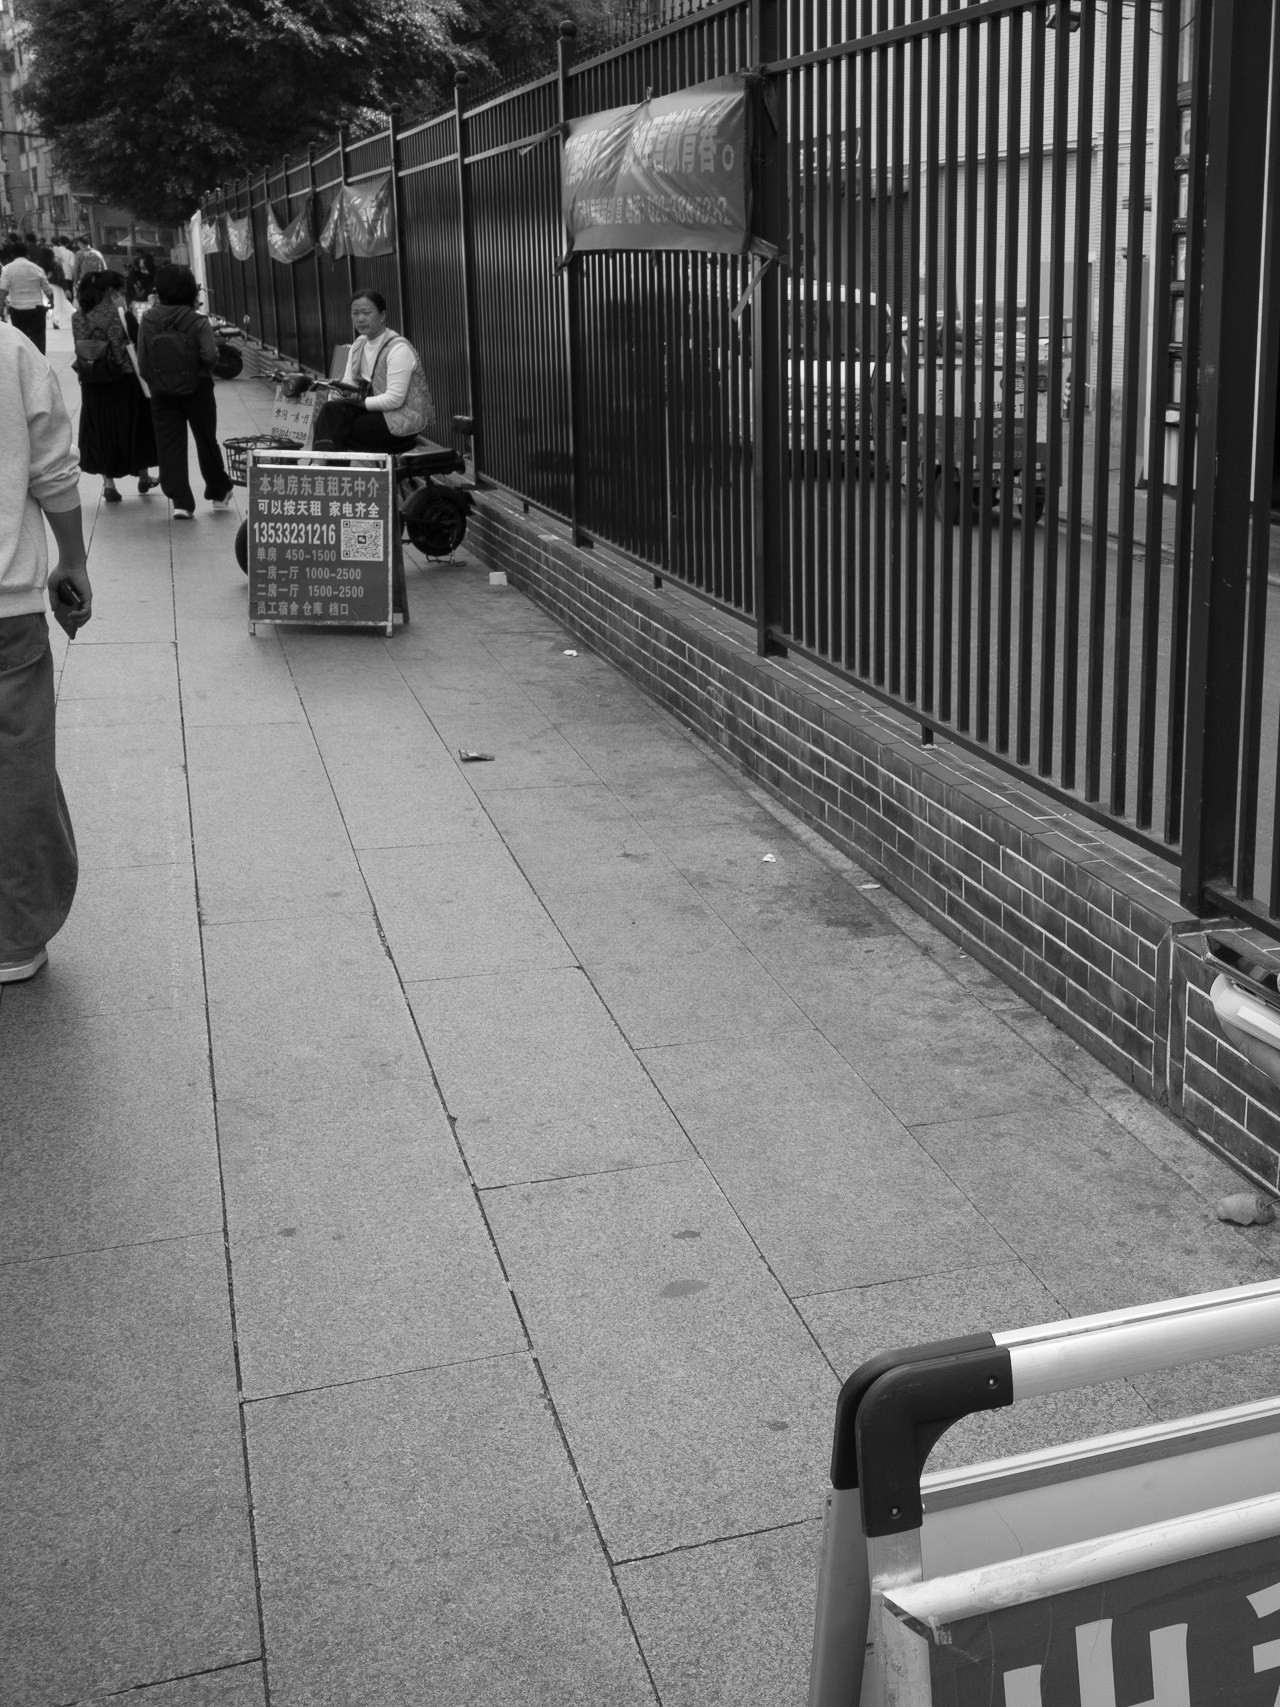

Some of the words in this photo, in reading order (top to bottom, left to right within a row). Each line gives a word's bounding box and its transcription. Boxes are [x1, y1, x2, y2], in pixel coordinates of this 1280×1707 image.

[260, 474, 379, 498] 本地房东直租无中介
[257, 499, 321, 516] 可以按天租
[329, 501, 380, 518] 家电齐全
[254, 521, 336, 545] 13533231216
[256, 546, 277, 562] 单房
[285, 548, 336, 562] 450-1500
[256, 565, 299, 580] 一房一厅
[305, 567, 361, 580] 1000-2500
[256, 582, 299, 598] 二房一厅
[308, 585, 364, 598] 1500-2500
[257, 601, 299, 616] 员工宿舍
[302, 601, 323, 616] 仓库
[329, 602, 349, 616] 档口
